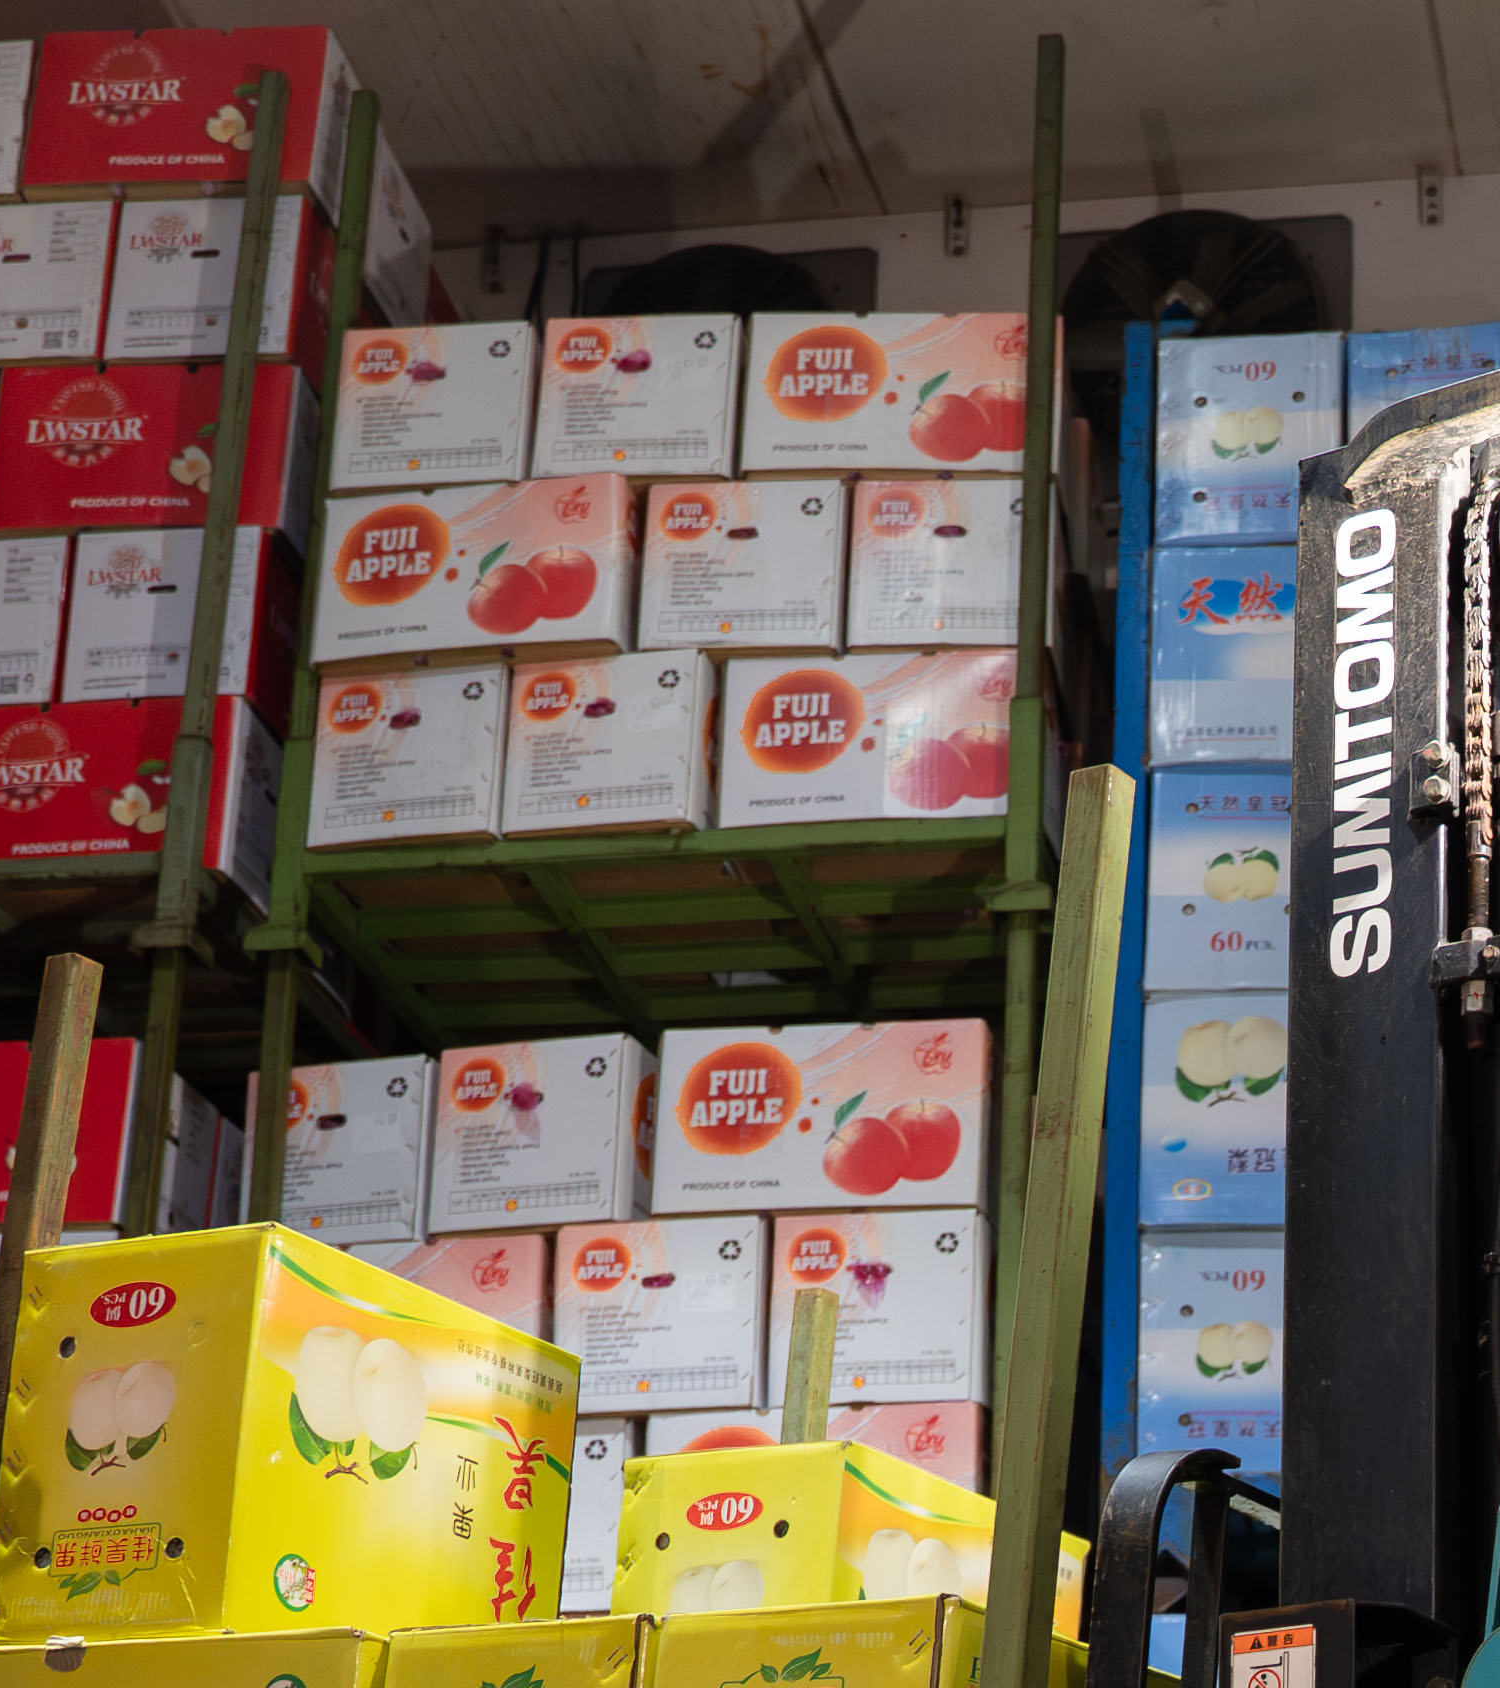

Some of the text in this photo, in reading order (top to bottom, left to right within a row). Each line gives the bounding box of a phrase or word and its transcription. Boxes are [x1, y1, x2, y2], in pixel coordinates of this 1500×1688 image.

[68, 78, 181, 105] LWSTAR
[796, 347, 854, 371] FUJI
[1245, 361, 1277, 383] 60
[778, 372, 870, 401] APPLE
[26, 417, 143, 444] LWSTAR
[363, 525, 419, 554] FUJI
[344, 550, 434, 583] APPLE
[1179, 572, 1284, 626] 天然
[772, 692, 831, 719] FUJI
[754, 718, 847, 749] APPLE
[1329, 507, 1397, 979] SUMITOMO
[1198, 795, 1290, 811] 天然皇冠
[1210, 930, 1243, 952] 60
[464, 1068, 492, 1085] FUJI
[708, 1067, 768, 1096] FUJI
[453, 1080, 500, 1102] APPLE
[687, 1097, 786, 1128] APPLE
[1227, 1148, 1285, 1174] 冠梨
[681, 1179, 781, 1191] PRODUCE OF CHINA
[584, 1248, 616, 1266] FUJI
[790, 1251, 841, 1272] APPLE
[799, 1239, 831, 1258] FUJI
[575, 1259, 625, 1280] APPLE
[1232, 1269, 1266, 1292] 60
[128, 1286, 166, 1318] 60
[452, 1453, 480, 1541] 果业
[720, 1495, 756, 1526] 60
[57, 1525, 157, 1539] JIAHAOXIANGUO
[488, 1416, 546, 1623] 佳昊
[54, 1534, 154, 1568] 佳昊鲜果
